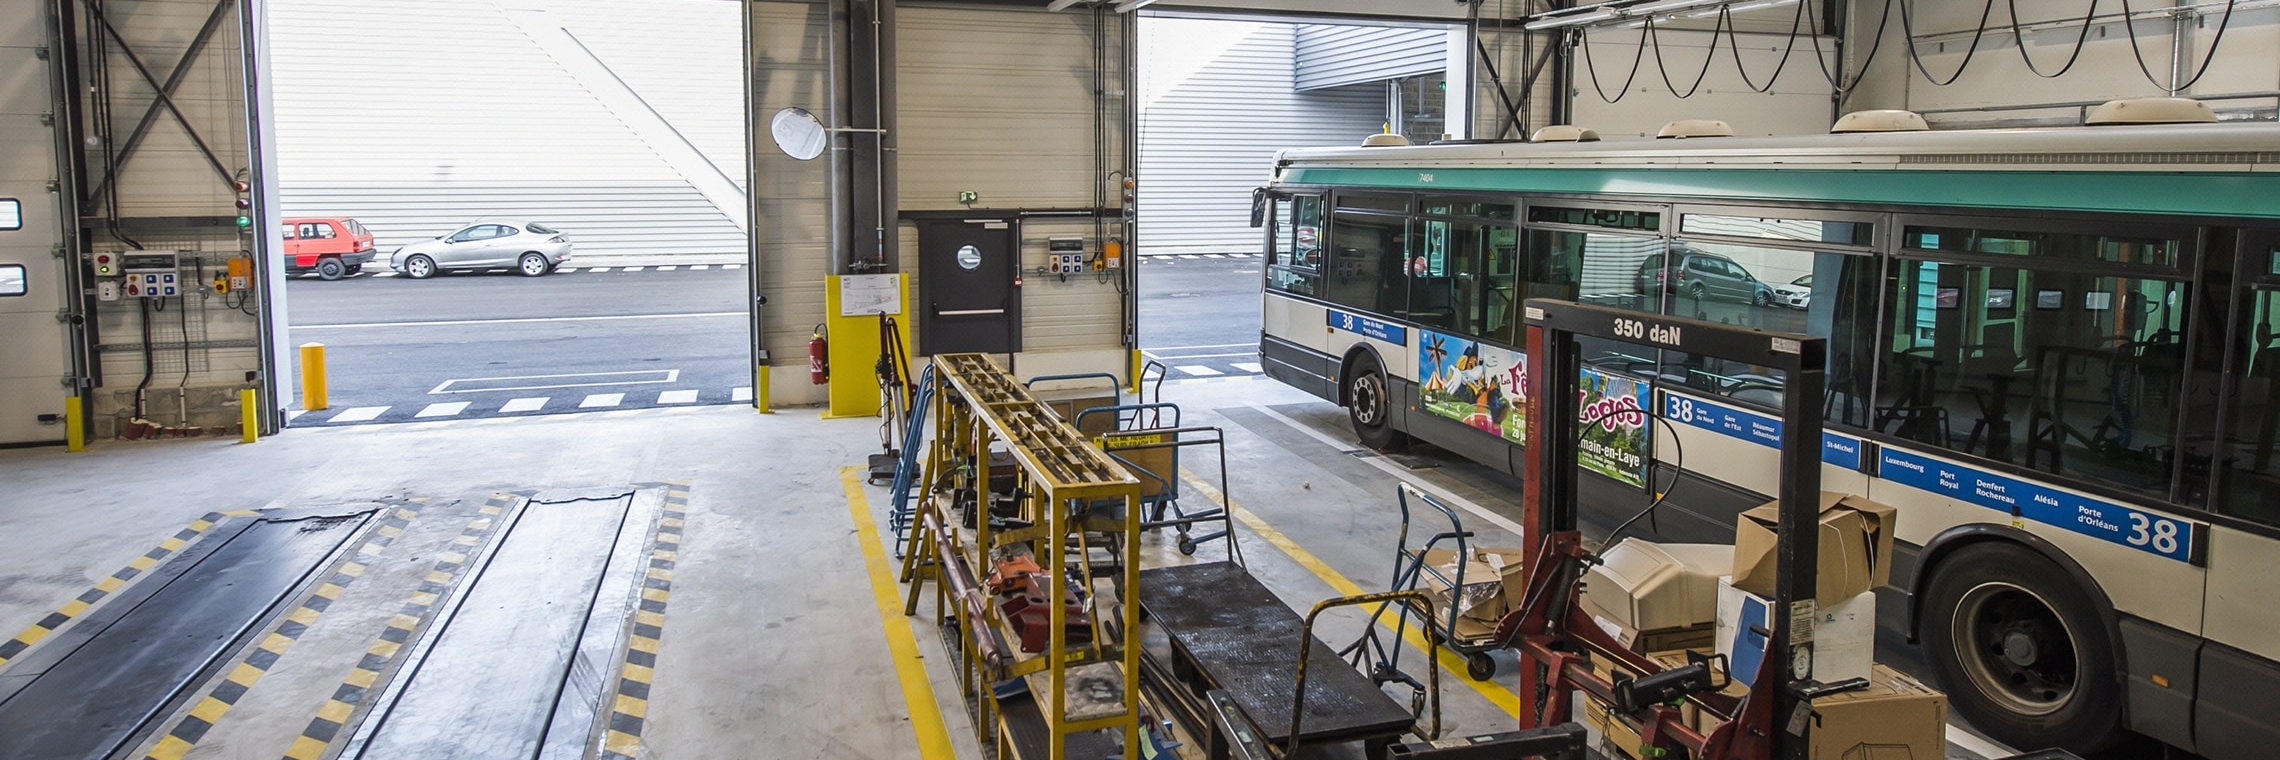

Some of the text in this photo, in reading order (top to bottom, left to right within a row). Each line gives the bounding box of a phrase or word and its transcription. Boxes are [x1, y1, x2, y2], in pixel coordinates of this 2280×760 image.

[1419, 173, 1433, 182] 7404
[1343, 314, 1353, 330] 38
[1614, 318, 1681, 346] 350 daN
[1509, 361, 1527, 396] Fê
[1670, 396, 1693, 422] 38
[1702, 416, 1714, 424] Nord
[1752, 422, 1775, 432] Réaumur
[1752, 429, 1780, 441] Sébastopol
[1578, 438, 1640, 468] main-en-Laye
[1826, 441, 1853, 454] St-Michel
[1885, 456, 1924, 473] Luxembourg
[1940, 470, 1955, 480] Port
[1940, 478, 1959, 490] Royal
[1976, 479, 2005, 493] Denfert
[1976, 487, 2015, 504] Rochereau
[2034, 494, 2059, 507] Alésia
[2078, 505, 2102, 518] Porte
[2077, 515, 2119, 532] d'Orléans
[2126, 512, 2178, 554] 38
